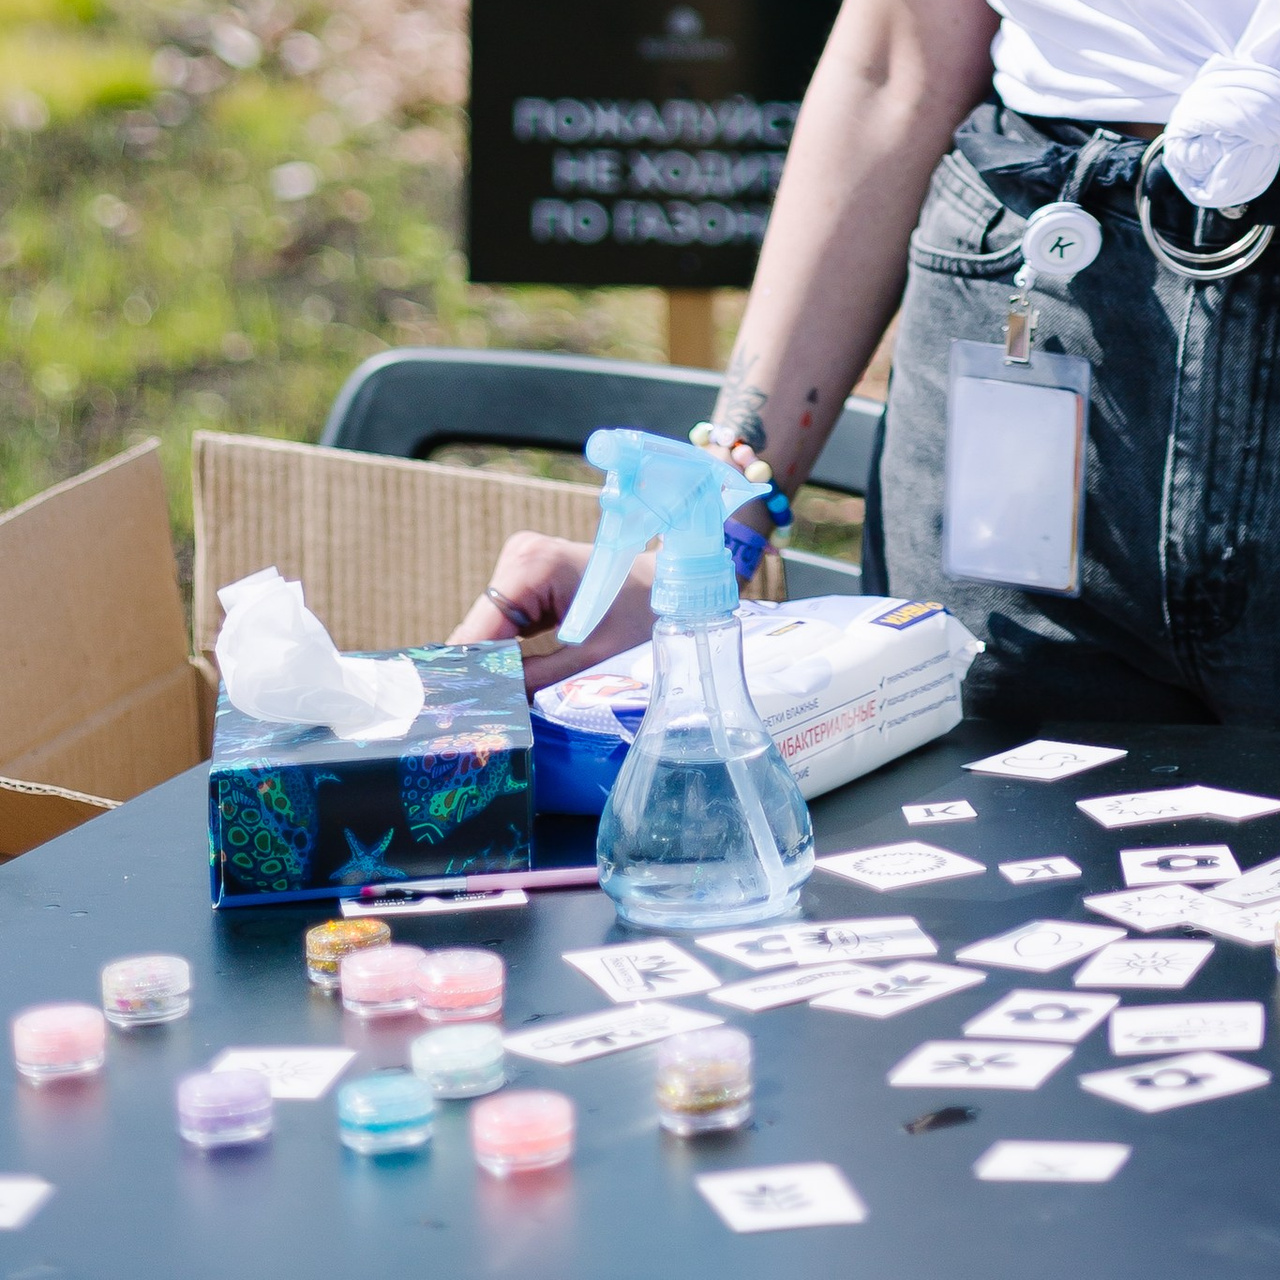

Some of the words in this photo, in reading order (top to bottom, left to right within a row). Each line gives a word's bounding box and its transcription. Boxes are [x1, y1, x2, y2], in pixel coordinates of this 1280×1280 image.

[512, 93, 801, 142] ПОЖАЛУЙС
[552, 149, 623, 195] НЕ
[531, 198, 609, 244] ПО
[777, 699, 877, 759] ИБАКТЕРИАЛЬНЫЕ
